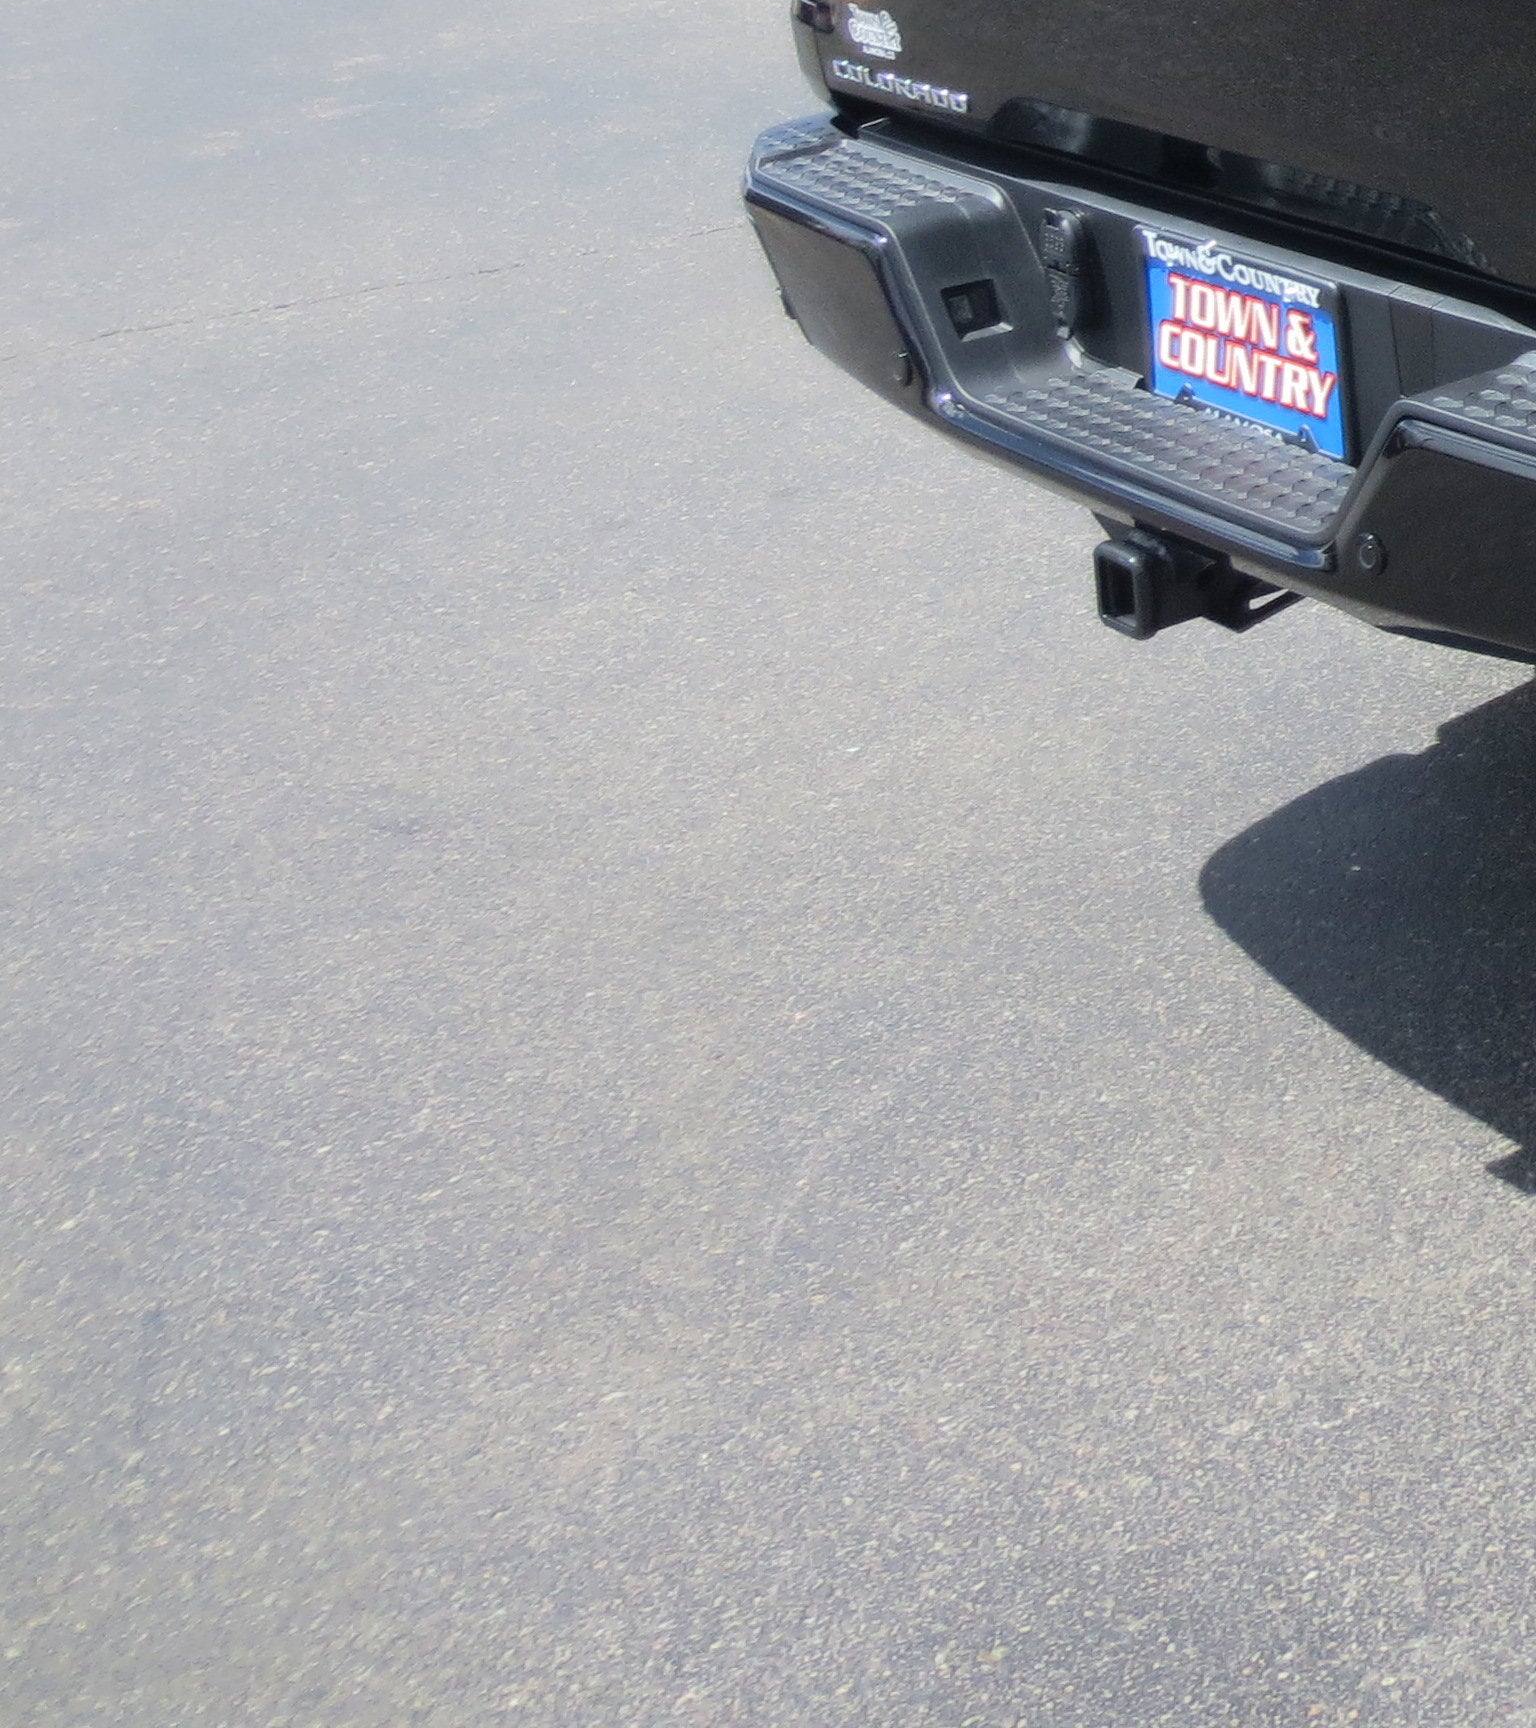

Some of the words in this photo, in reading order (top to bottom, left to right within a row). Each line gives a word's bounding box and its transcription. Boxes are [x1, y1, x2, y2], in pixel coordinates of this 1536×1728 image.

[832, 59, 968, 114] COLORADO
[1168, 272, 1280, 352] TOWN
[1286, 309, 1318, 364] &
[1158, 319, 1337, 419] COUNTRY
